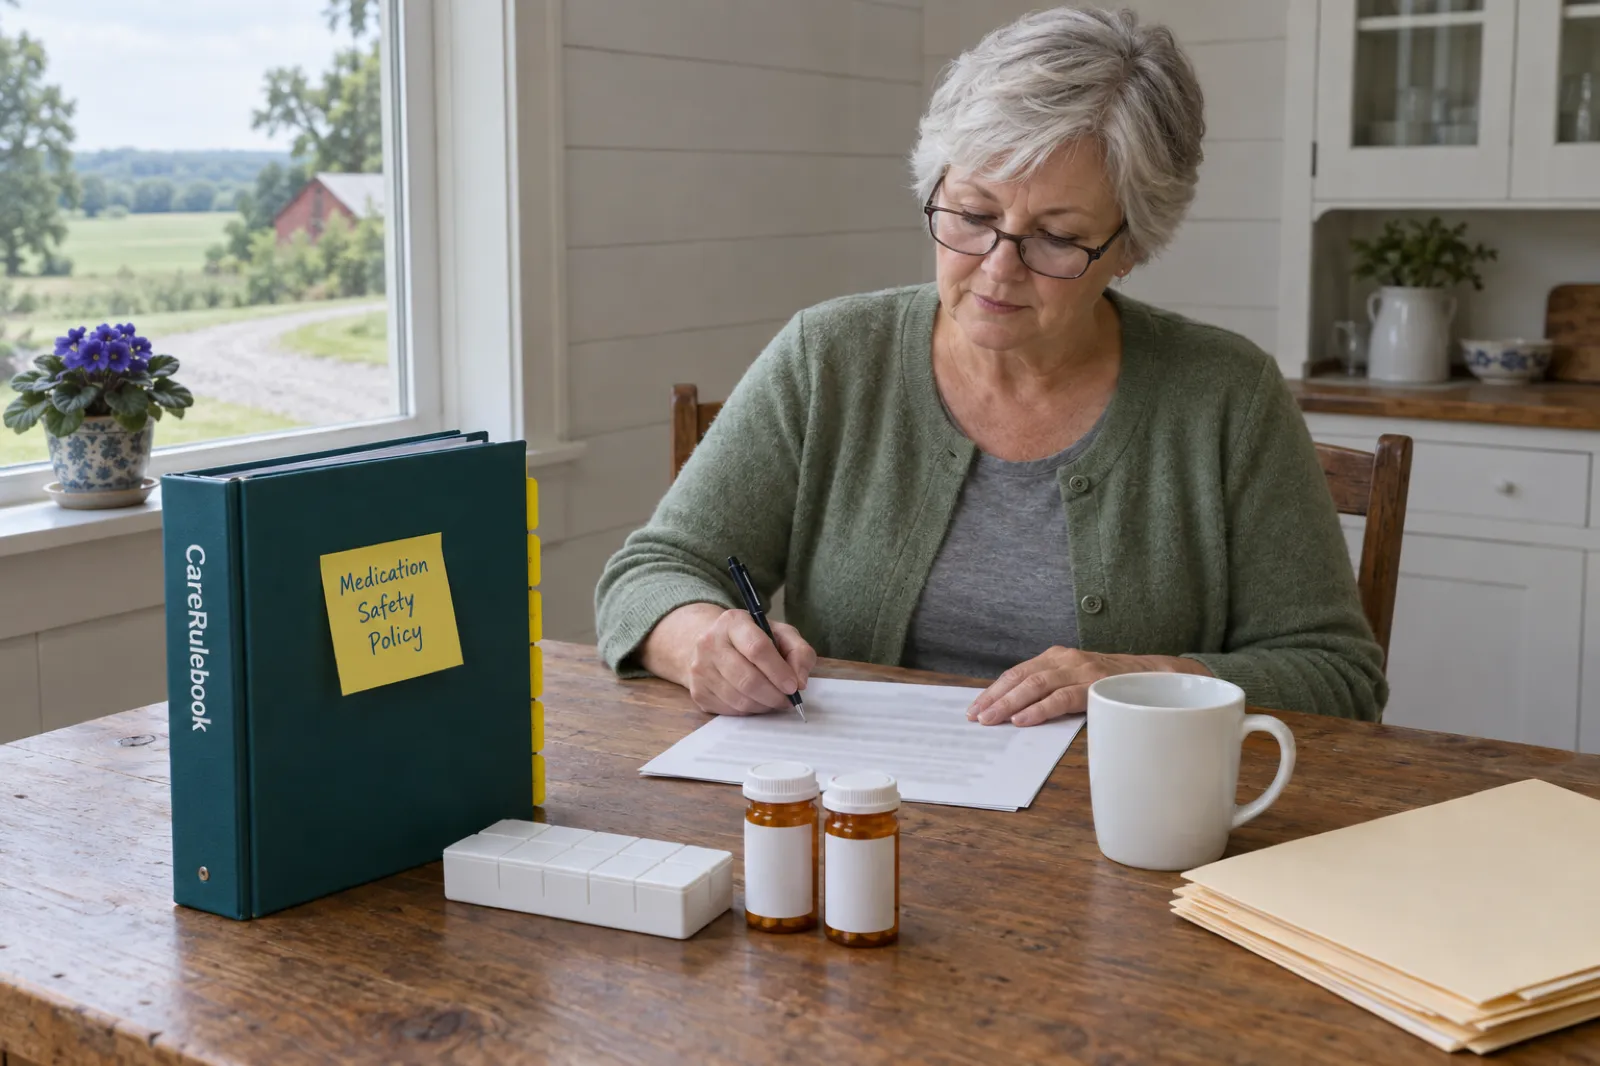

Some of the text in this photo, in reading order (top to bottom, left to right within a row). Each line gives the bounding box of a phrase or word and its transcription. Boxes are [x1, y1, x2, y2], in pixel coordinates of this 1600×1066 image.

[340, 558, 429, 597] Medication
[358, 591, 414, 624] Safety
[186, 544, 212, 732] CareRulebook
[368, 625, 423, 656] Policy
